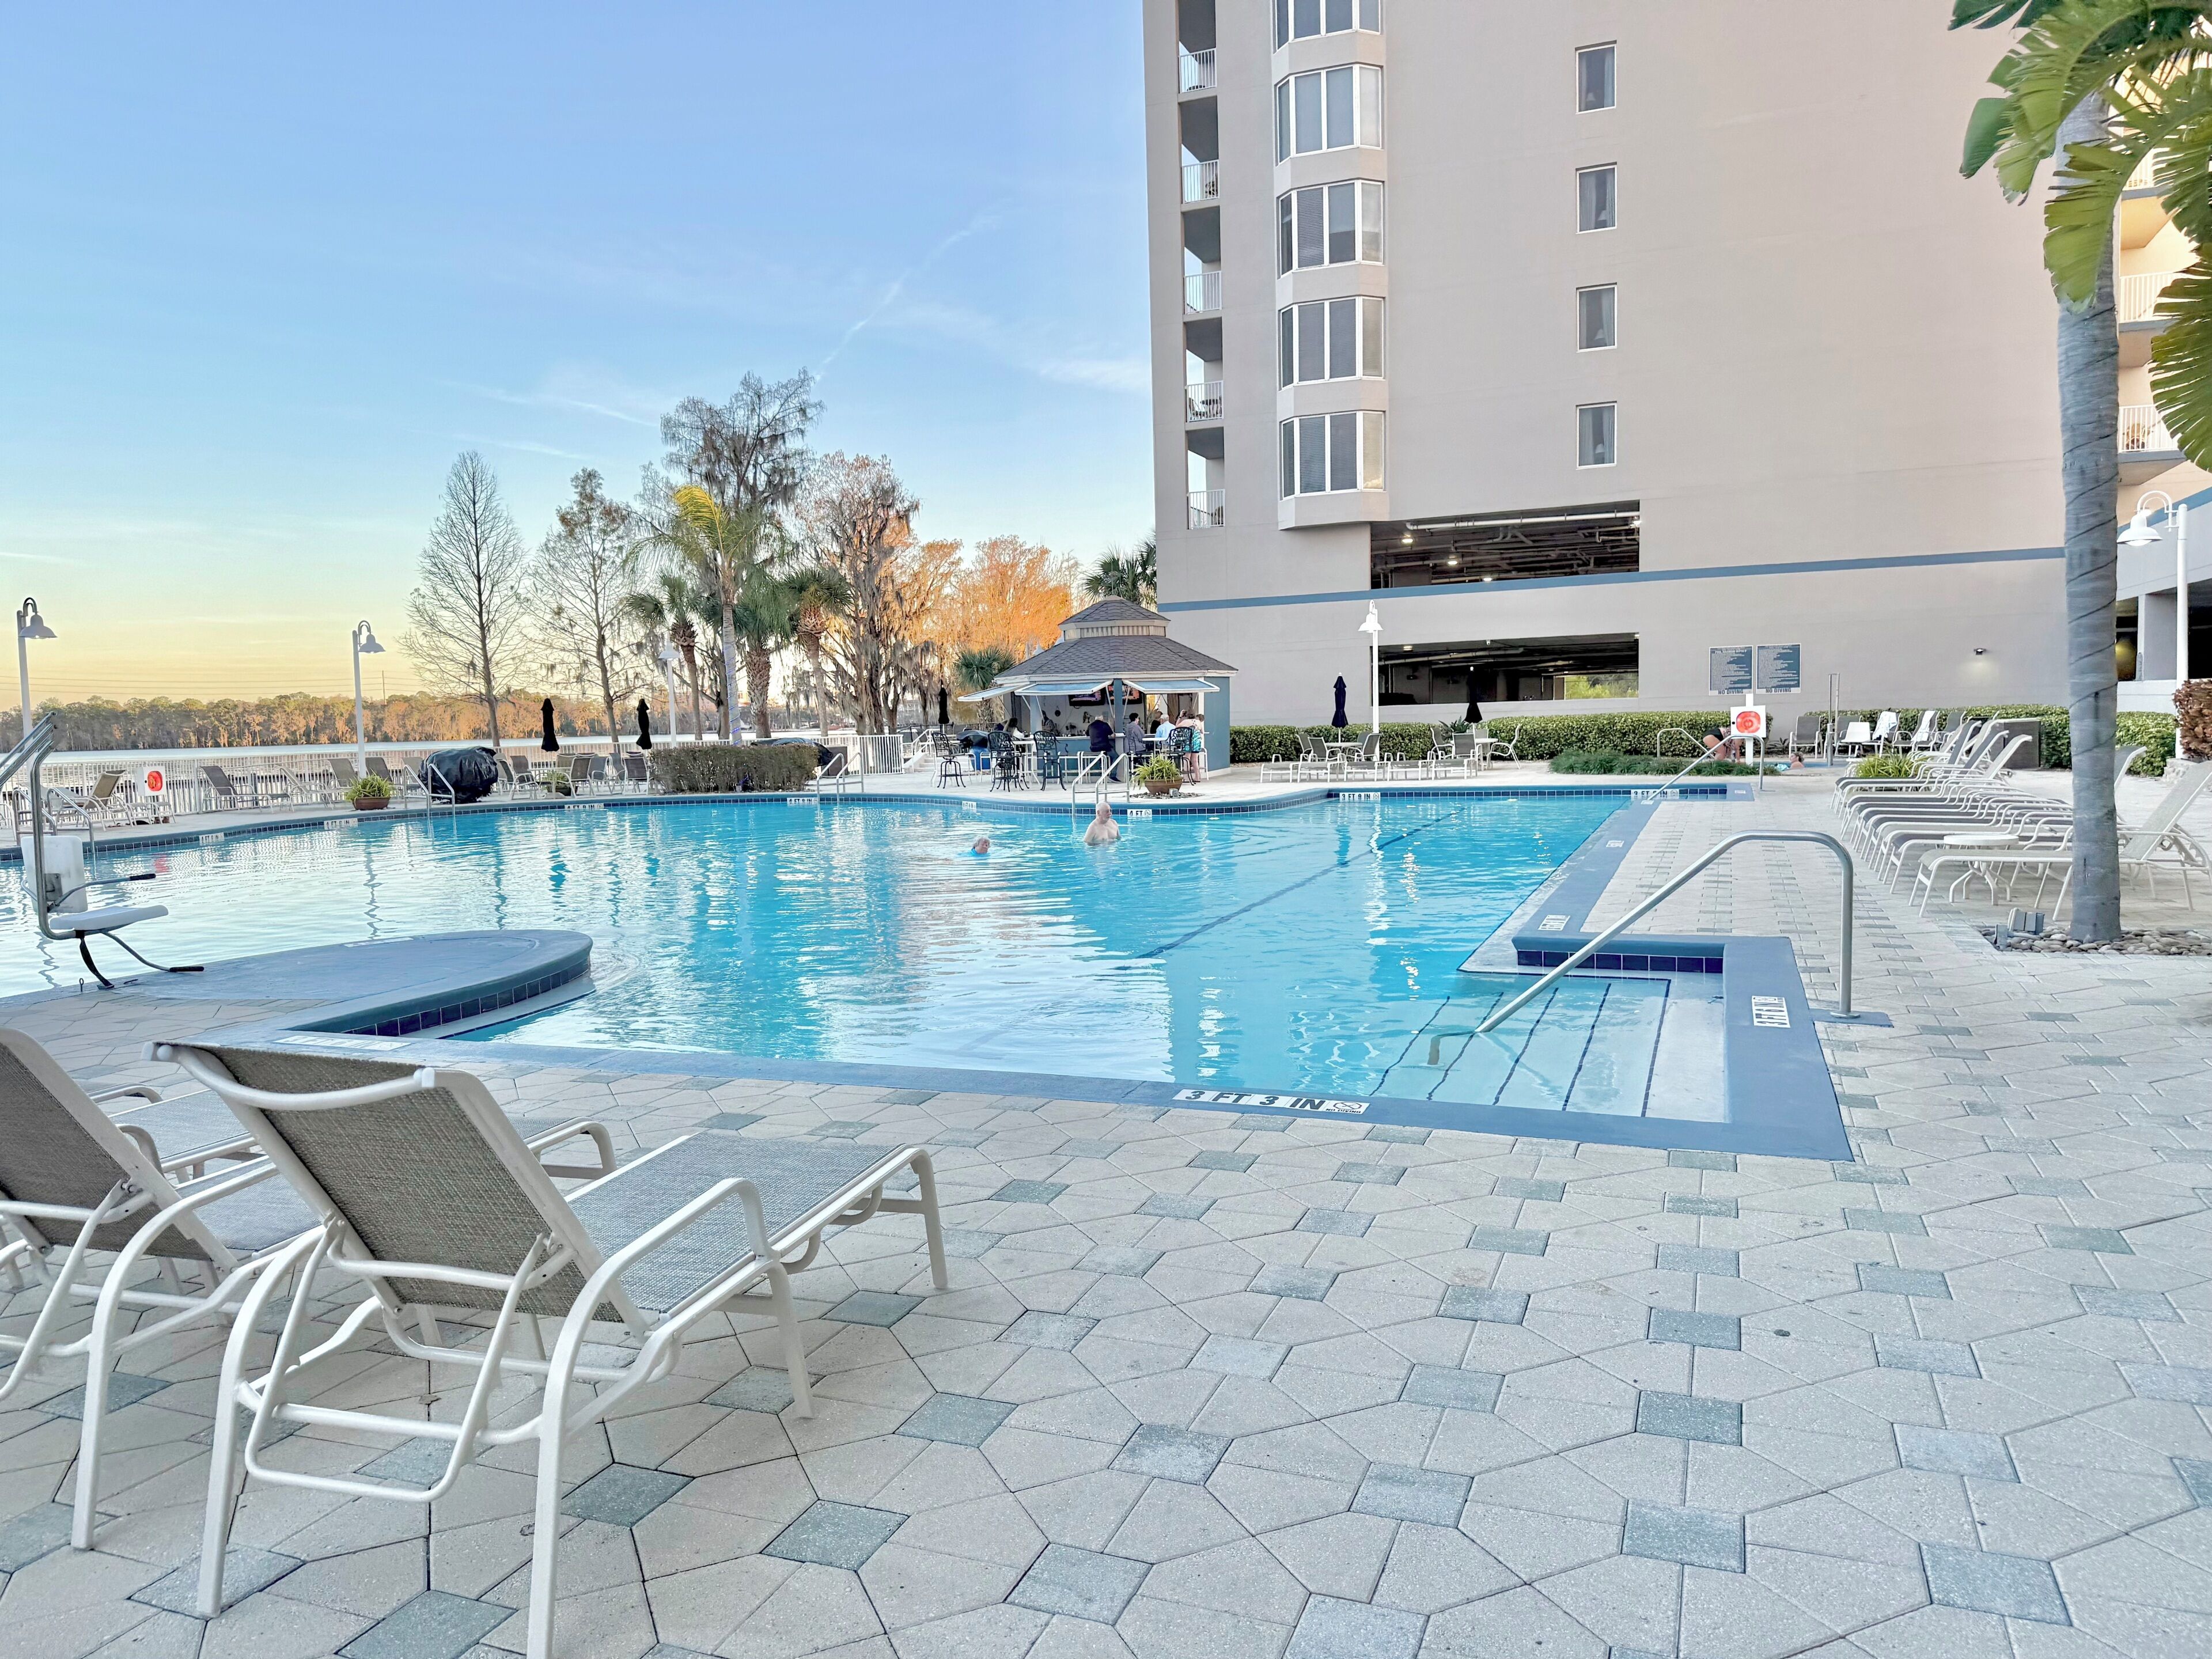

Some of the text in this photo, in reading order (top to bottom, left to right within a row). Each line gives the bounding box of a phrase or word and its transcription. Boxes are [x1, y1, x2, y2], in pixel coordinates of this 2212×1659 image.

[1185, 1090, 1326, 1110] 3 FT 3 IN
